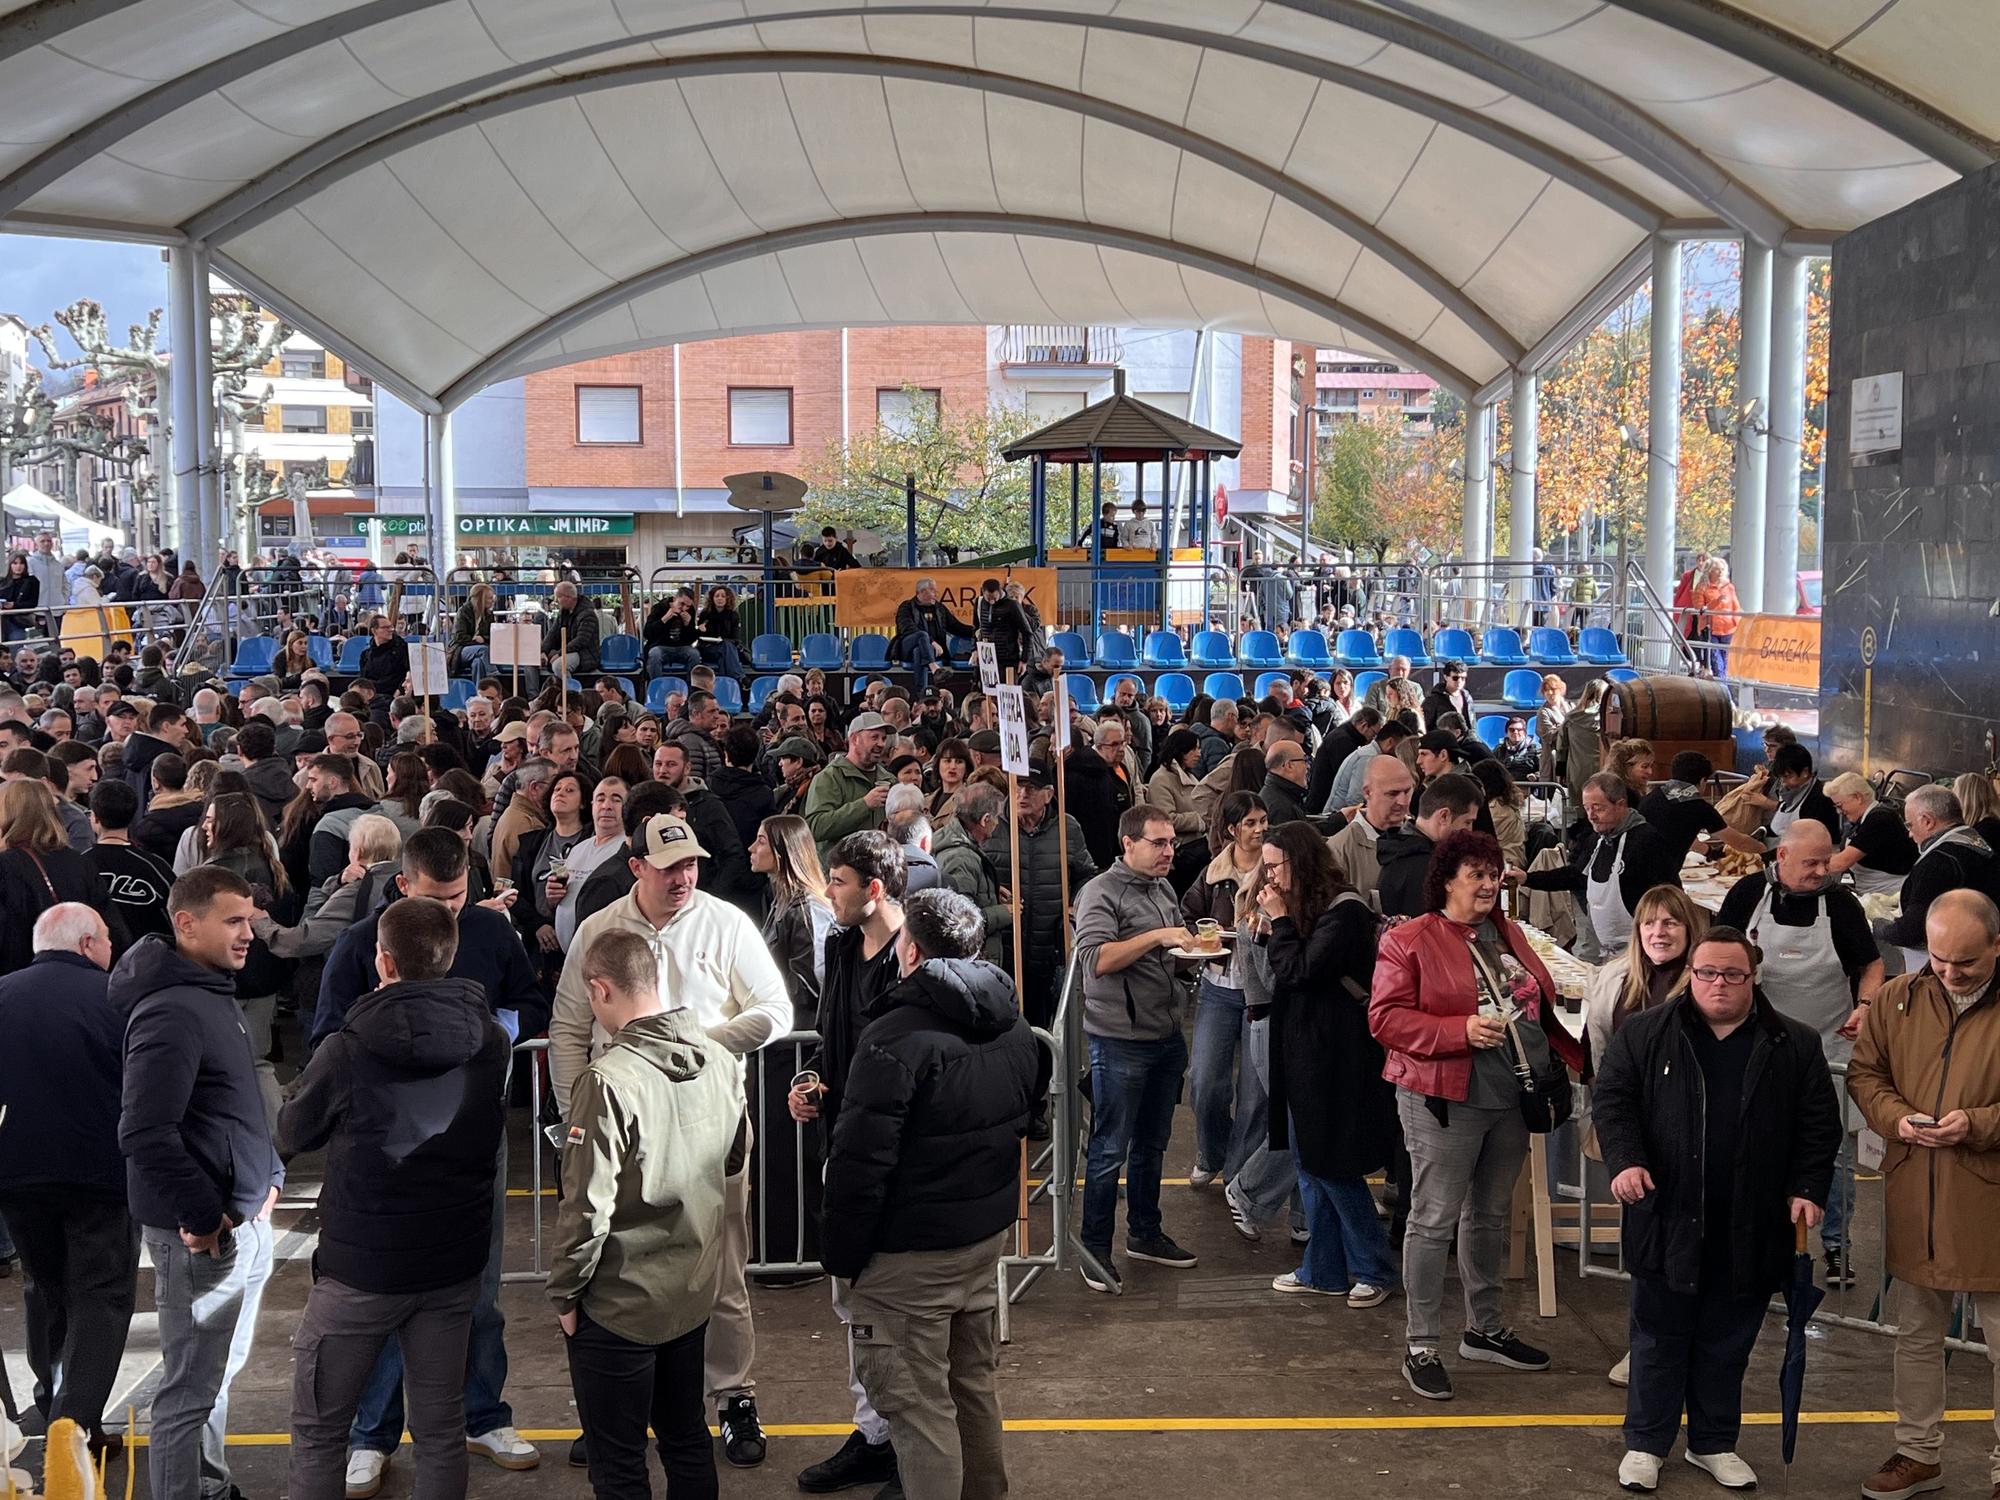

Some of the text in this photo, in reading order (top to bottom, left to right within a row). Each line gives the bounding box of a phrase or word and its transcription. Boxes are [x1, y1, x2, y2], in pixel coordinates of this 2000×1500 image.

[460, 518, 530, 532] OPTIKA
[1760, 636, 1816, 664] BAREAK
[1863, 634, 1874, 658] 8
